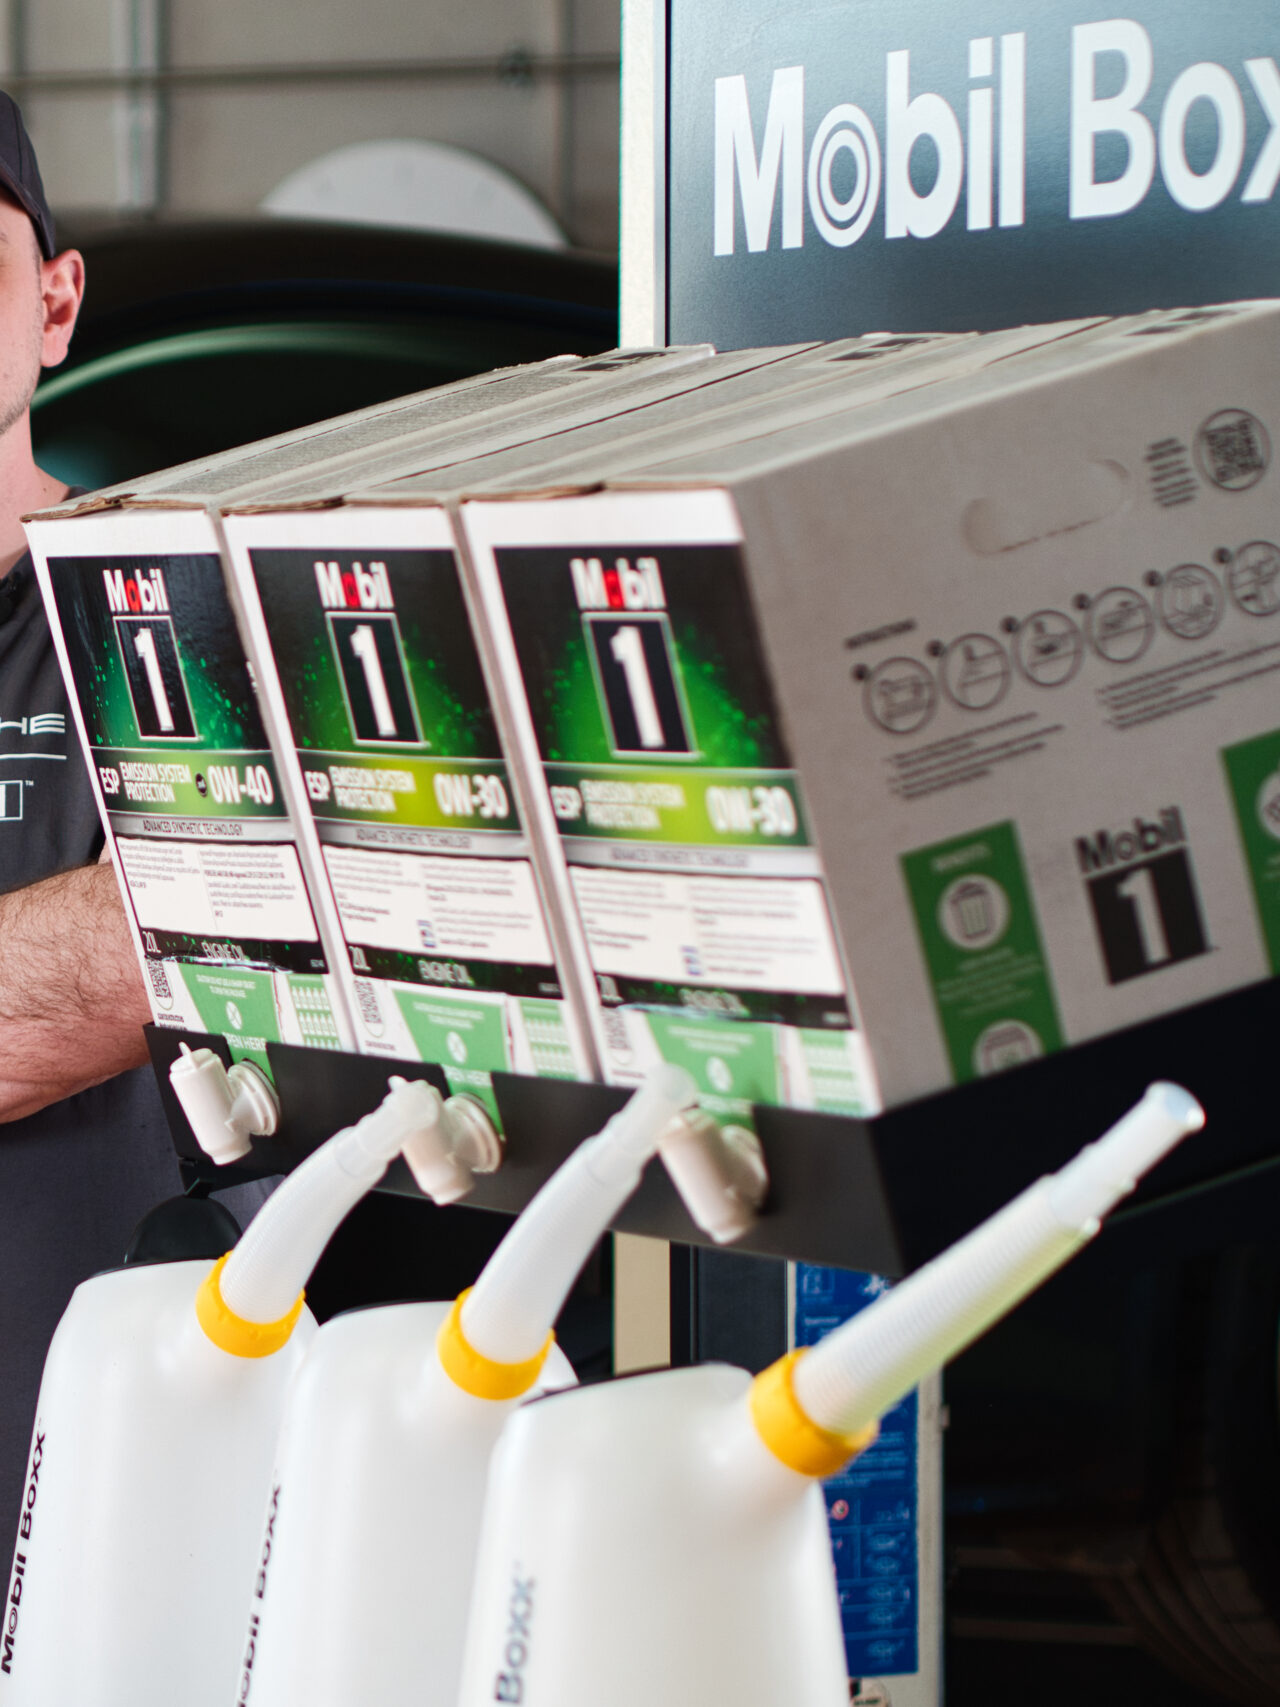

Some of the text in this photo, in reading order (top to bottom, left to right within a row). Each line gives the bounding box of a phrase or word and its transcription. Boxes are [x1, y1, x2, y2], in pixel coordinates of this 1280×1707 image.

[714, 31, 1026, 256] Mobil
[102, 568, 170, 613] Mobil
[313, 561, 394, 609] Mobil
[570, 557, 666, 610] Mobil
[134, 627, 175, 731] 1
[350, 624, 396, 736] 1
[610, 625, 665, 748] 1
[99, 767, 120, 794] ESP
[120, 761, 156, 782] EMISSION
[156, 764, 193, 783] SYSTEM
[207, 765, 275, 805] 0W-40
[124, 782, 176, 802] PROTECTION
[433, 773, 509, 818] 0W-30
[143, 820, 171, 833] ADVANCED
[1075, 805, 1186, 873] Mobil
[1118, 867, 1172, 965] 1
[1, 1432, 46, 1674] Mobil Boxx
